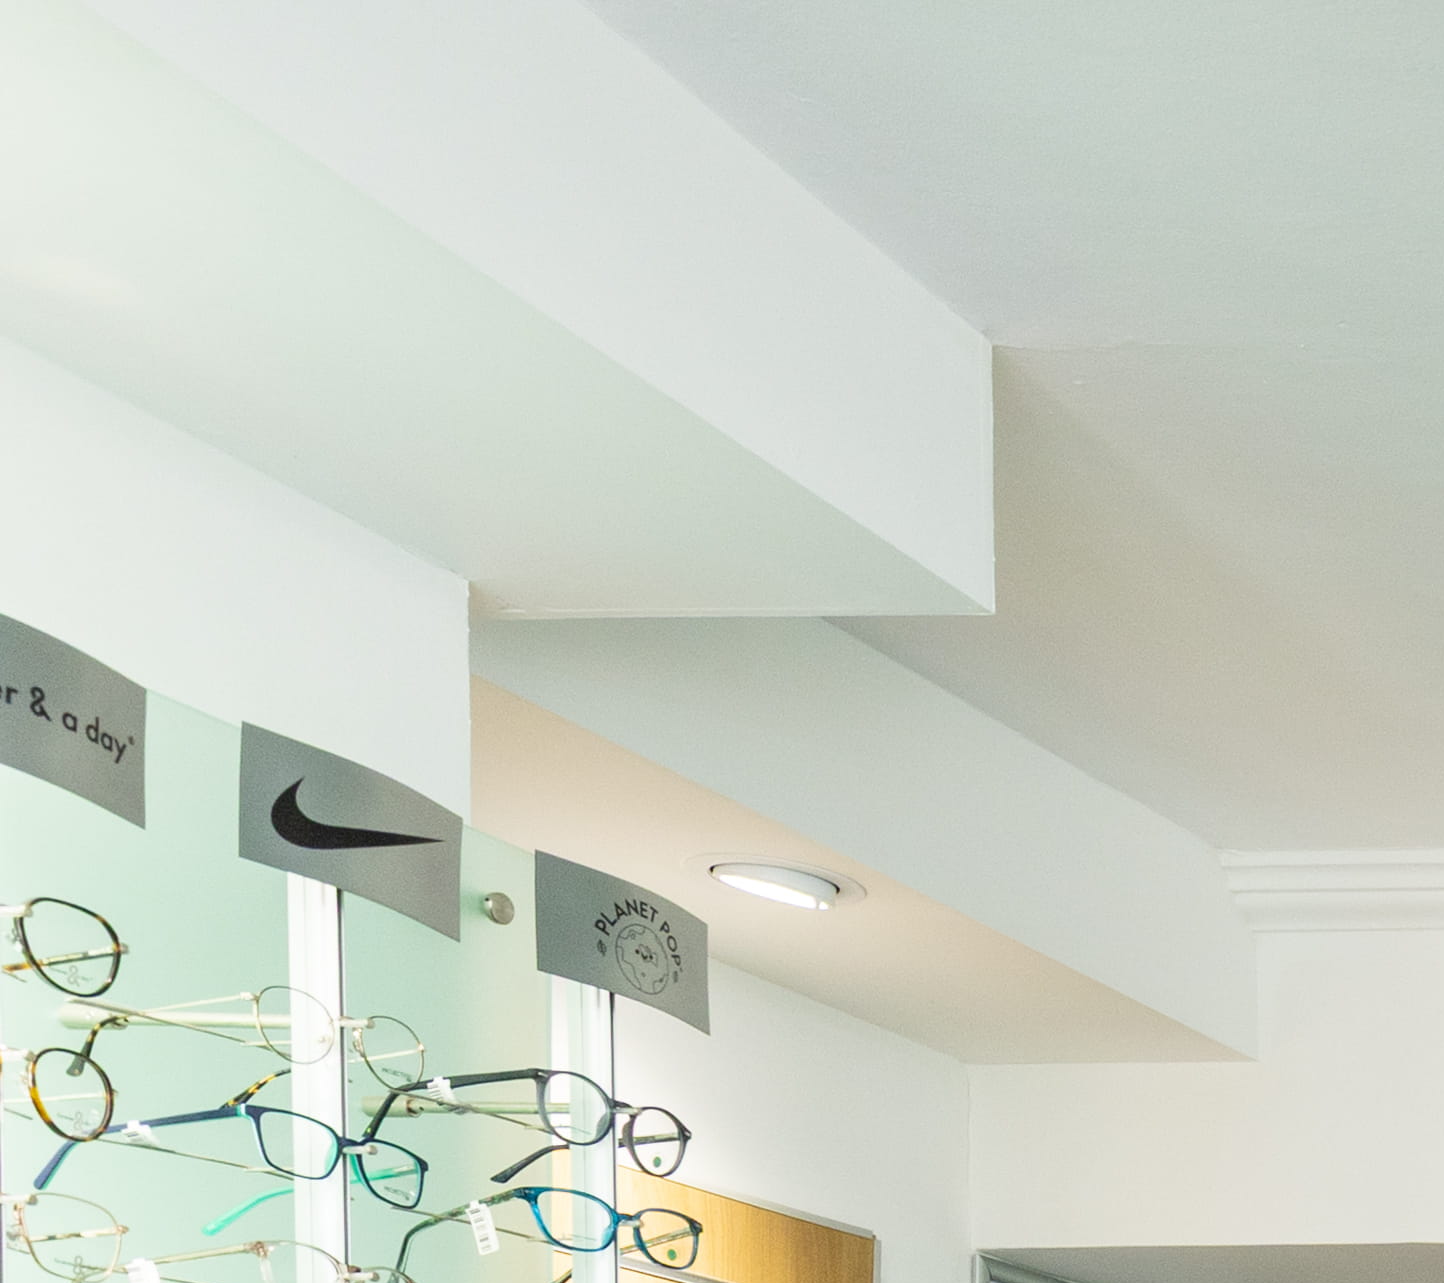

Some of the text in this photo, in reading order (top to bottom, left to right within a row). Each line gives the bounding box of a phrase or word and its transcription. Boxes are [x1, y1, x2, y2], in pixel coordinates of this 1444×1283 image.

[29, 686, 51, 722] &
[62, 713, 78, 732] a
[594, 898, 659, 936] PLANET
